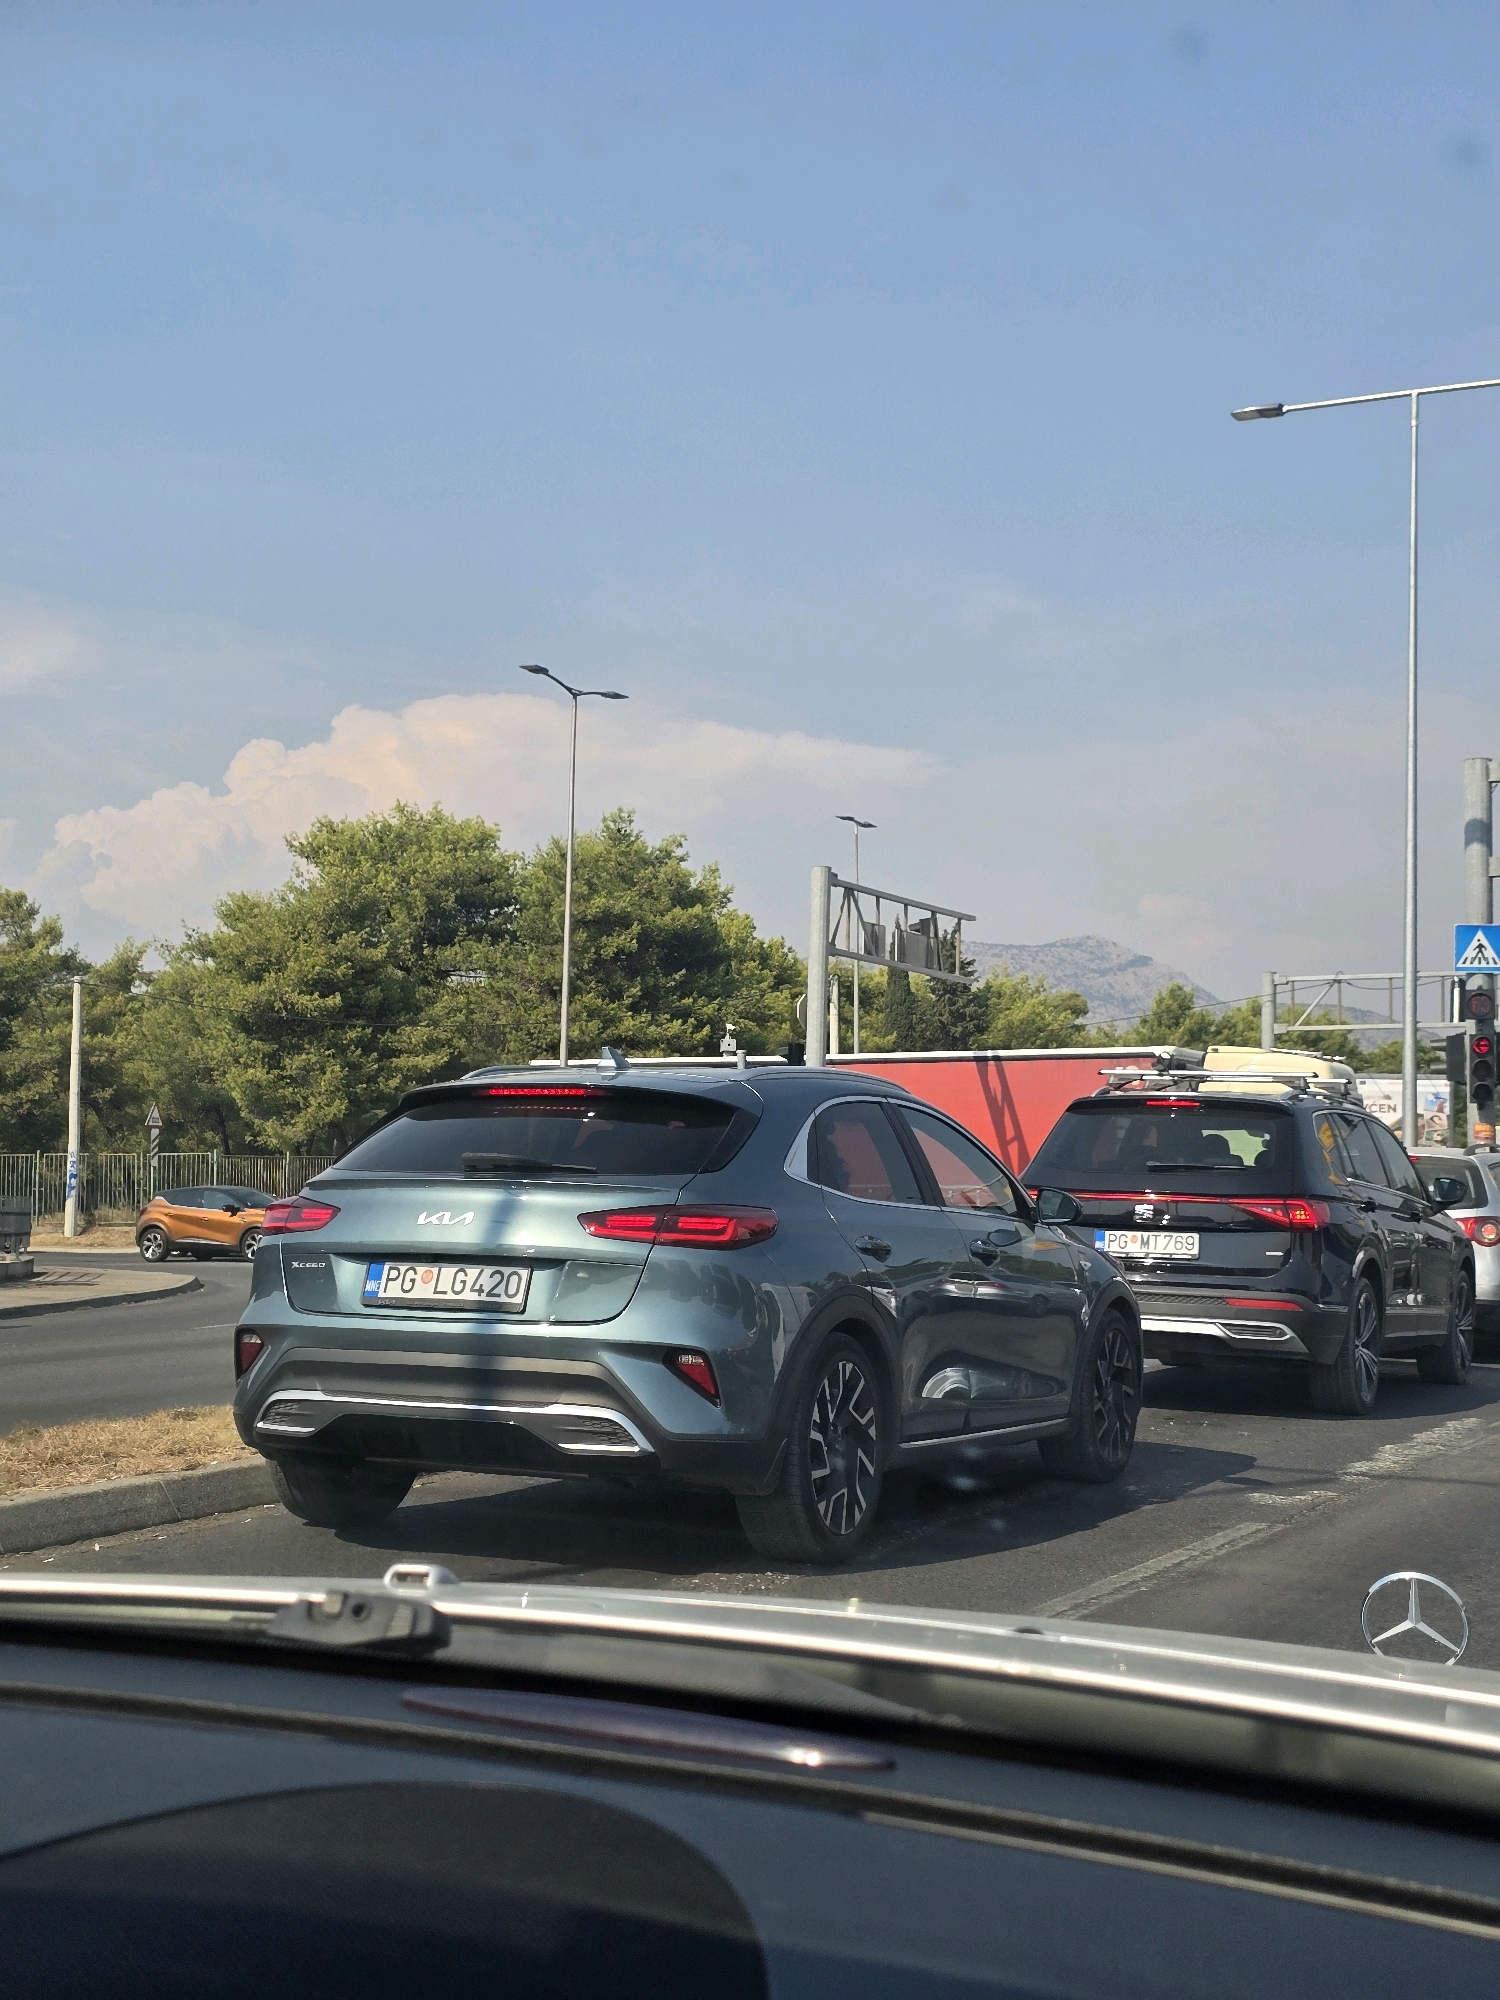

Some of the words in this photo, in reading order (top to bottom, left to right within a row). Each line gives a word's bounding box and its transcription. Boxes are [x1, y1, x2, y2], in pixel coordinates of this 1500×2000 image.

[417, 1211, 475, 1226] KIA
[1107, 1234, 1128, 1250] PG
[1139, 1234, 1195, 1251] MT769
[383, 1266, 418, 1294] PG
[433, 1267, 523, 1299] LG420
